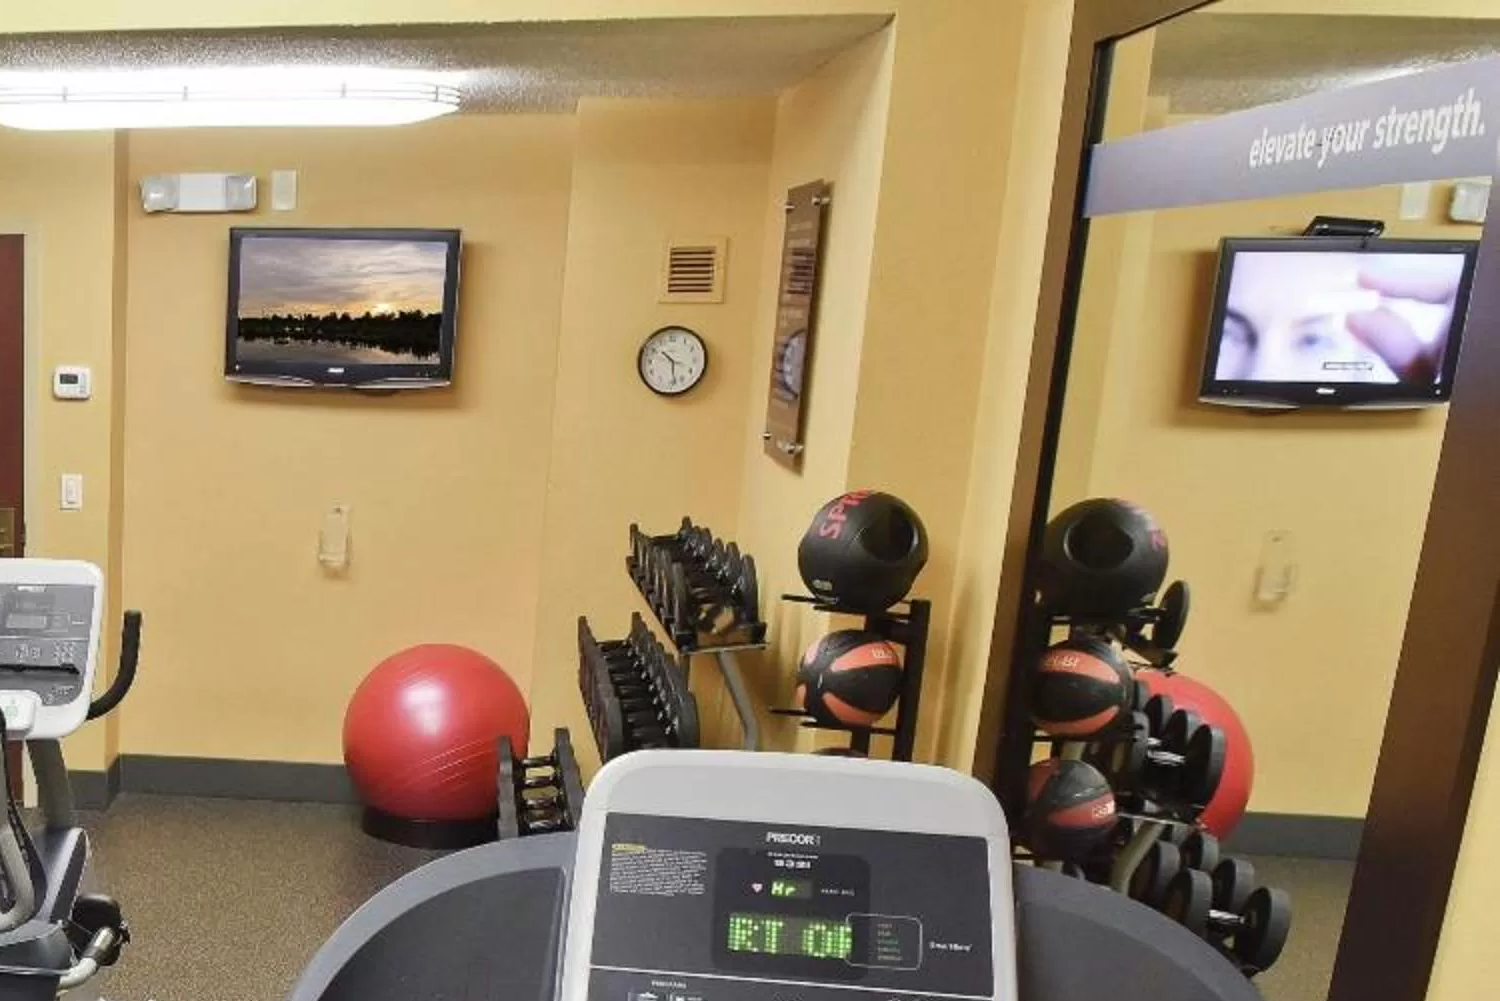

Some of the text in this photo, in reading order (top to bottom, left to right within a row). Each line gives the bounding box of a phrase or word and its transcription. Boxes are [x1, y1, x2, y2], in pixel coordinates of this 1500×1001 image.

[1249, 87, 1486, 168] elevate your strength.
[765, 831, 816, 845] PRECOR
